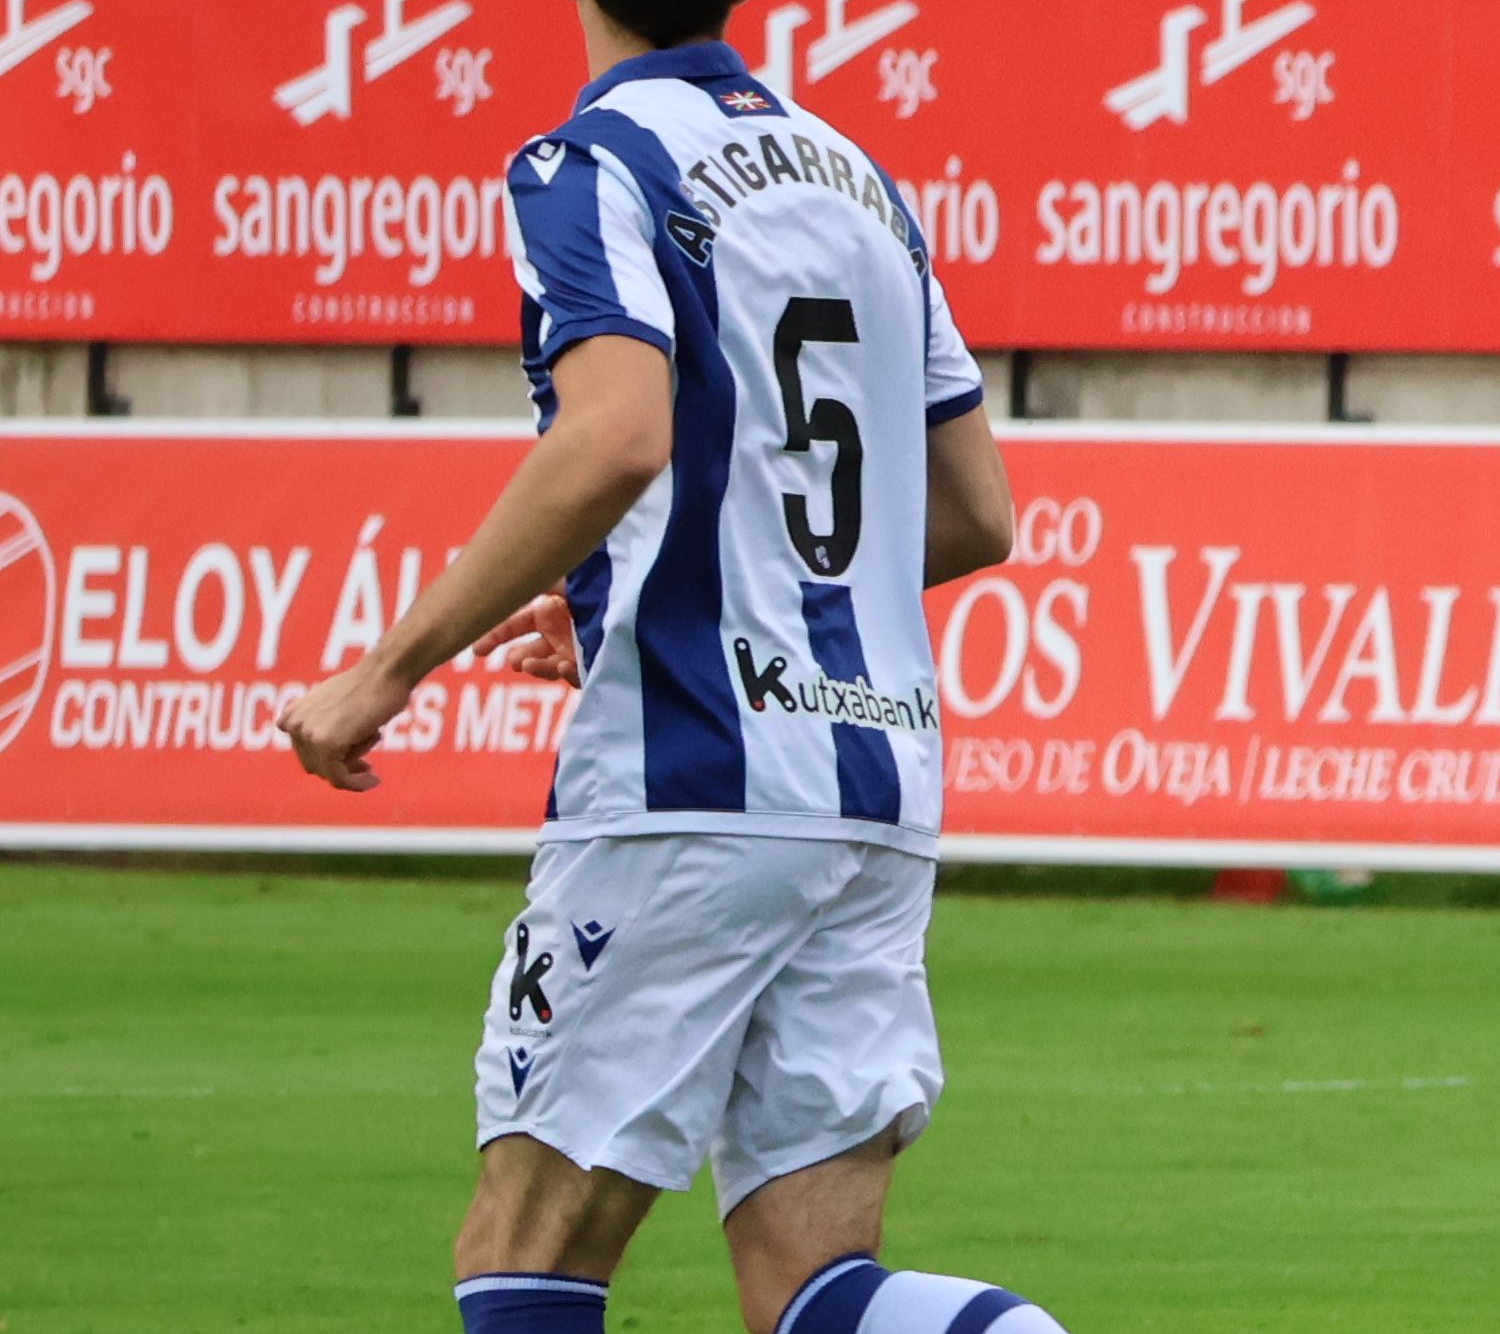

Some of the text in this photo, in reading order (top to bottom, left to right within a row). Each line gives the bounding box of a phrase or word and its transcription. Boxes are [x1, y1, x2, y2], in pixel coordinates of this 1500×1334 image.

[54, 46, 114, 116] sgc
[434, 47, 494, 117] sgc
[877, 48, 939, 119] sgc
[1272, 50, 1336, 120] sgc
[1036, 157, 1399, 296] sangregorio
[773, 296, 864, 577] 5
[61, 543, 310, 672] ELOY
[1259, 746, 1398, 801] LECHE
